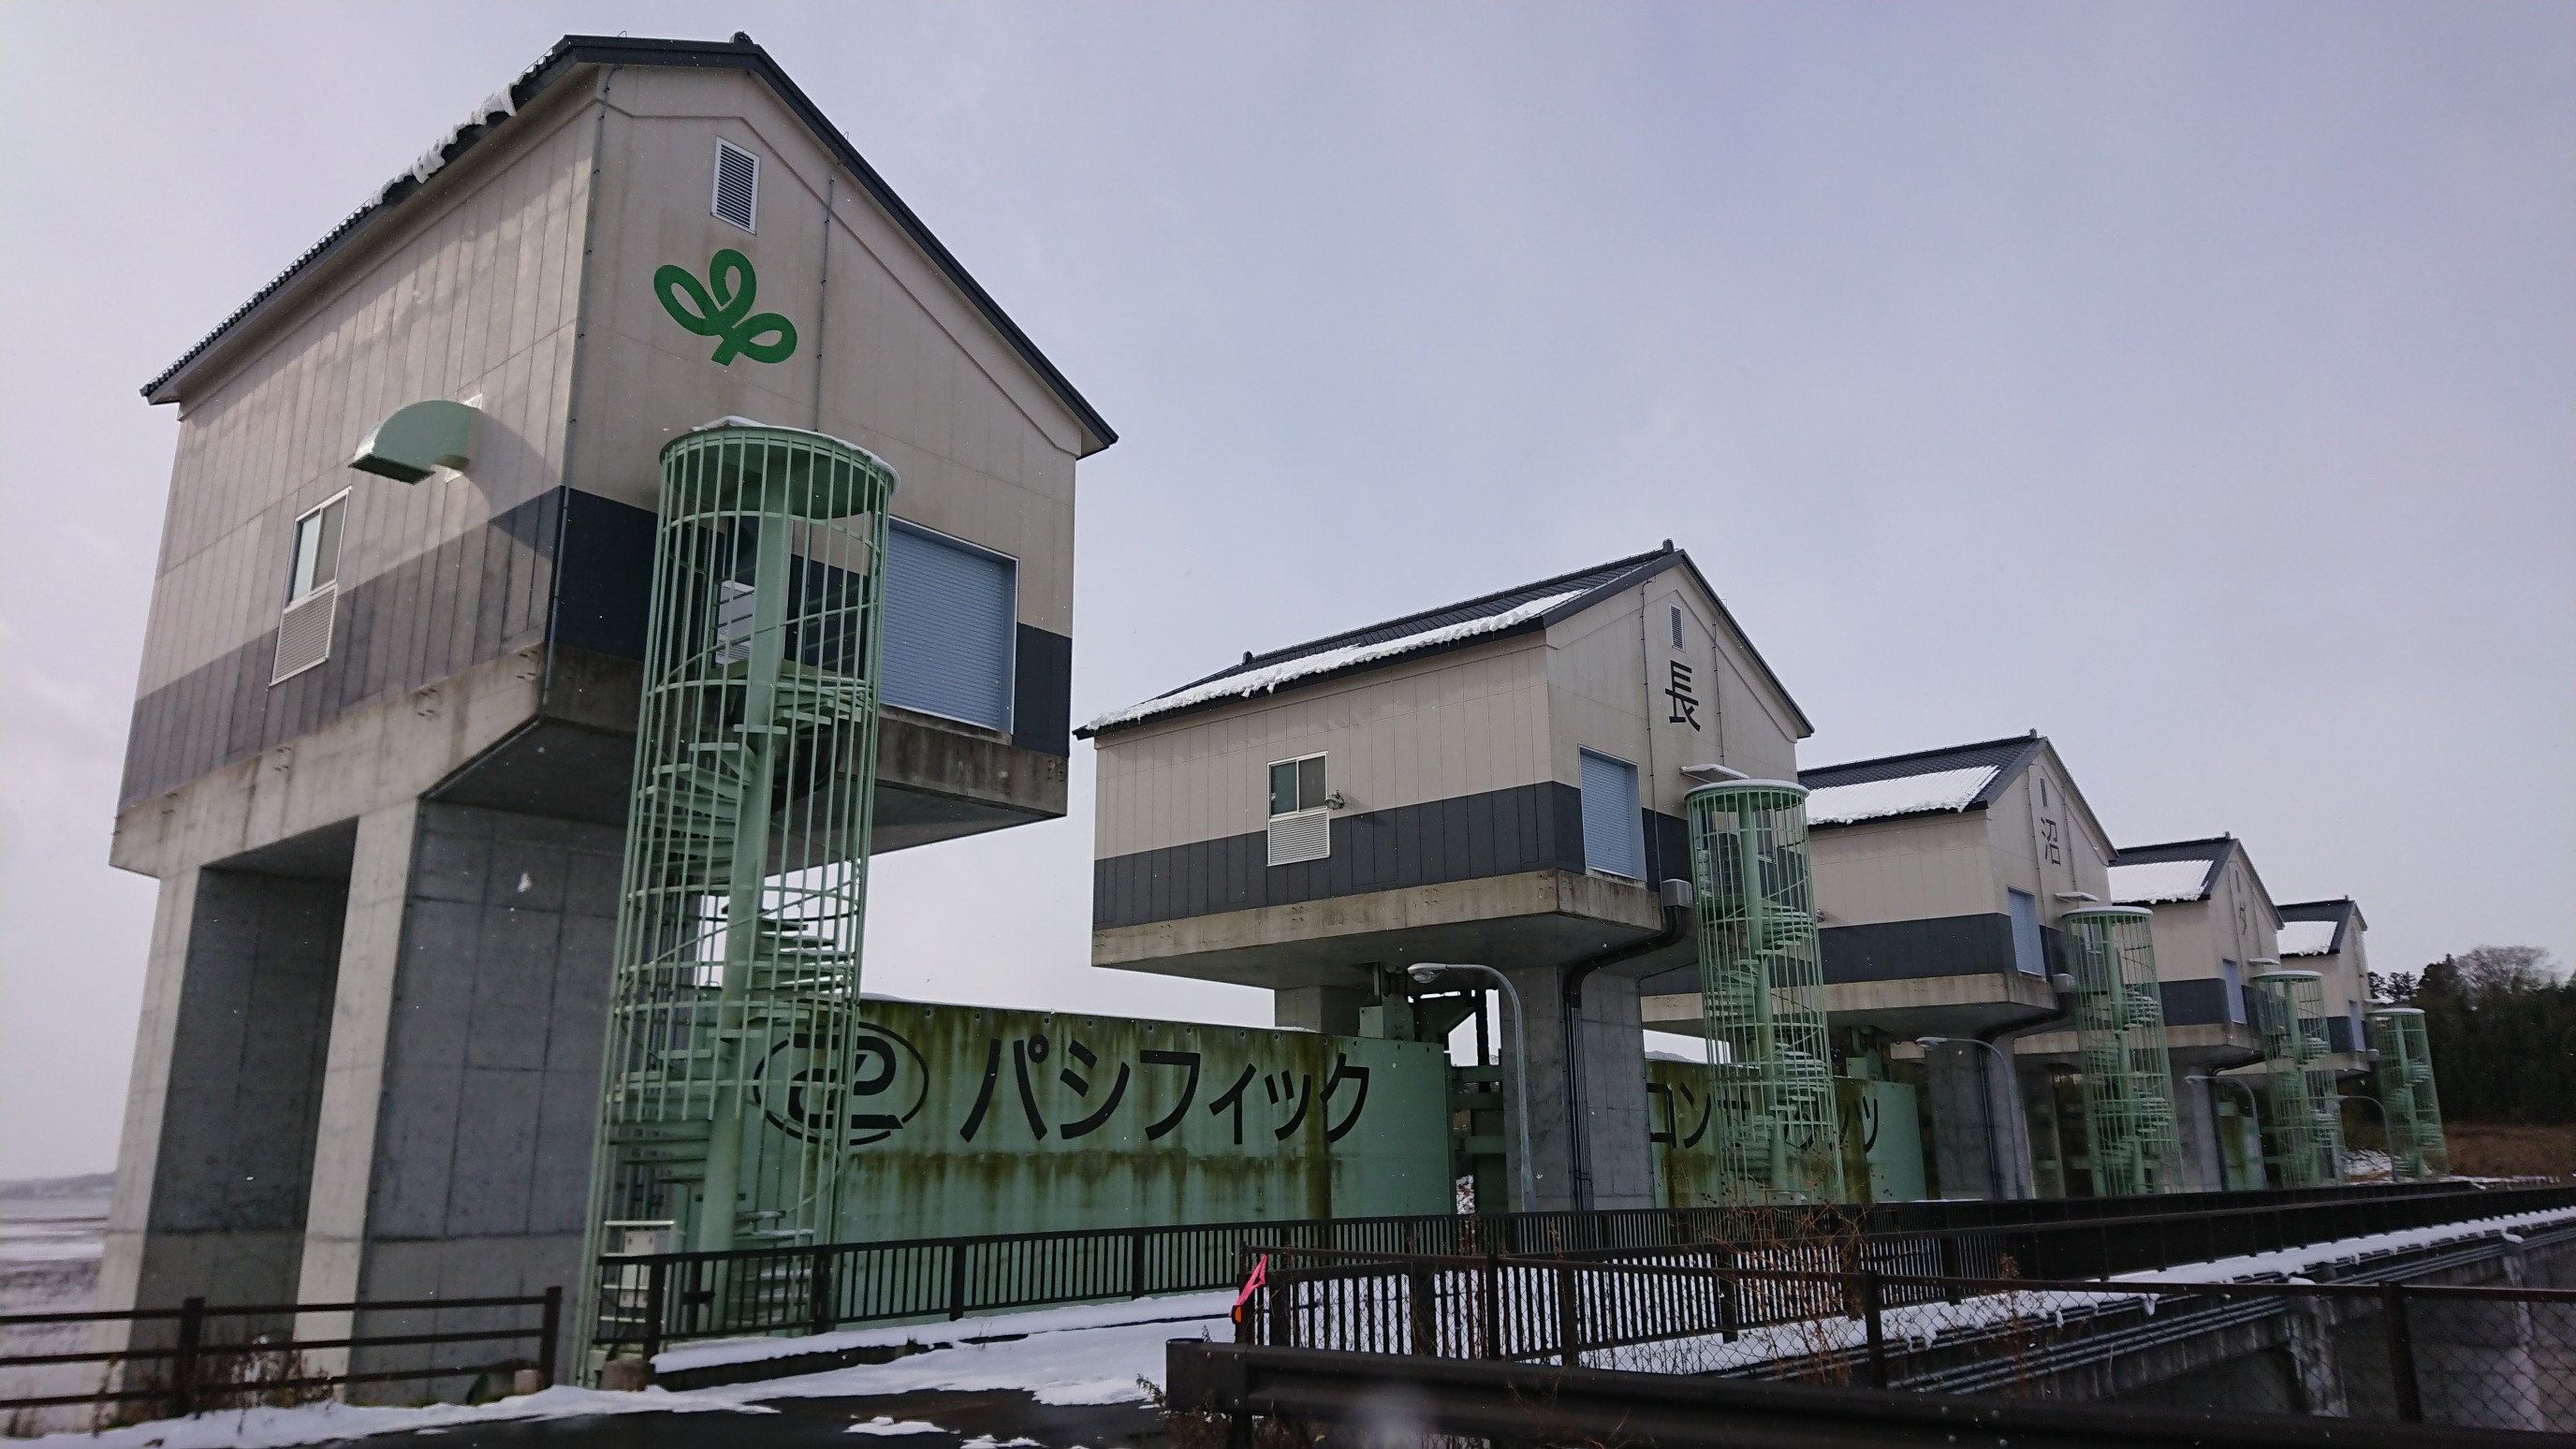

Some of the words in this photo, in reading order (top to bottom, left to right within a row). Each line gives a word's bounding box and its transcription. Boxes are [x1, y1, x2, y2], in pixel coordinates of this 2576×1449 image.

[1665, 660, 1701, 732] 長
[2041, 816, 2061, 867] 沼
[959, 1033, 1369, 1145] パシフィック
